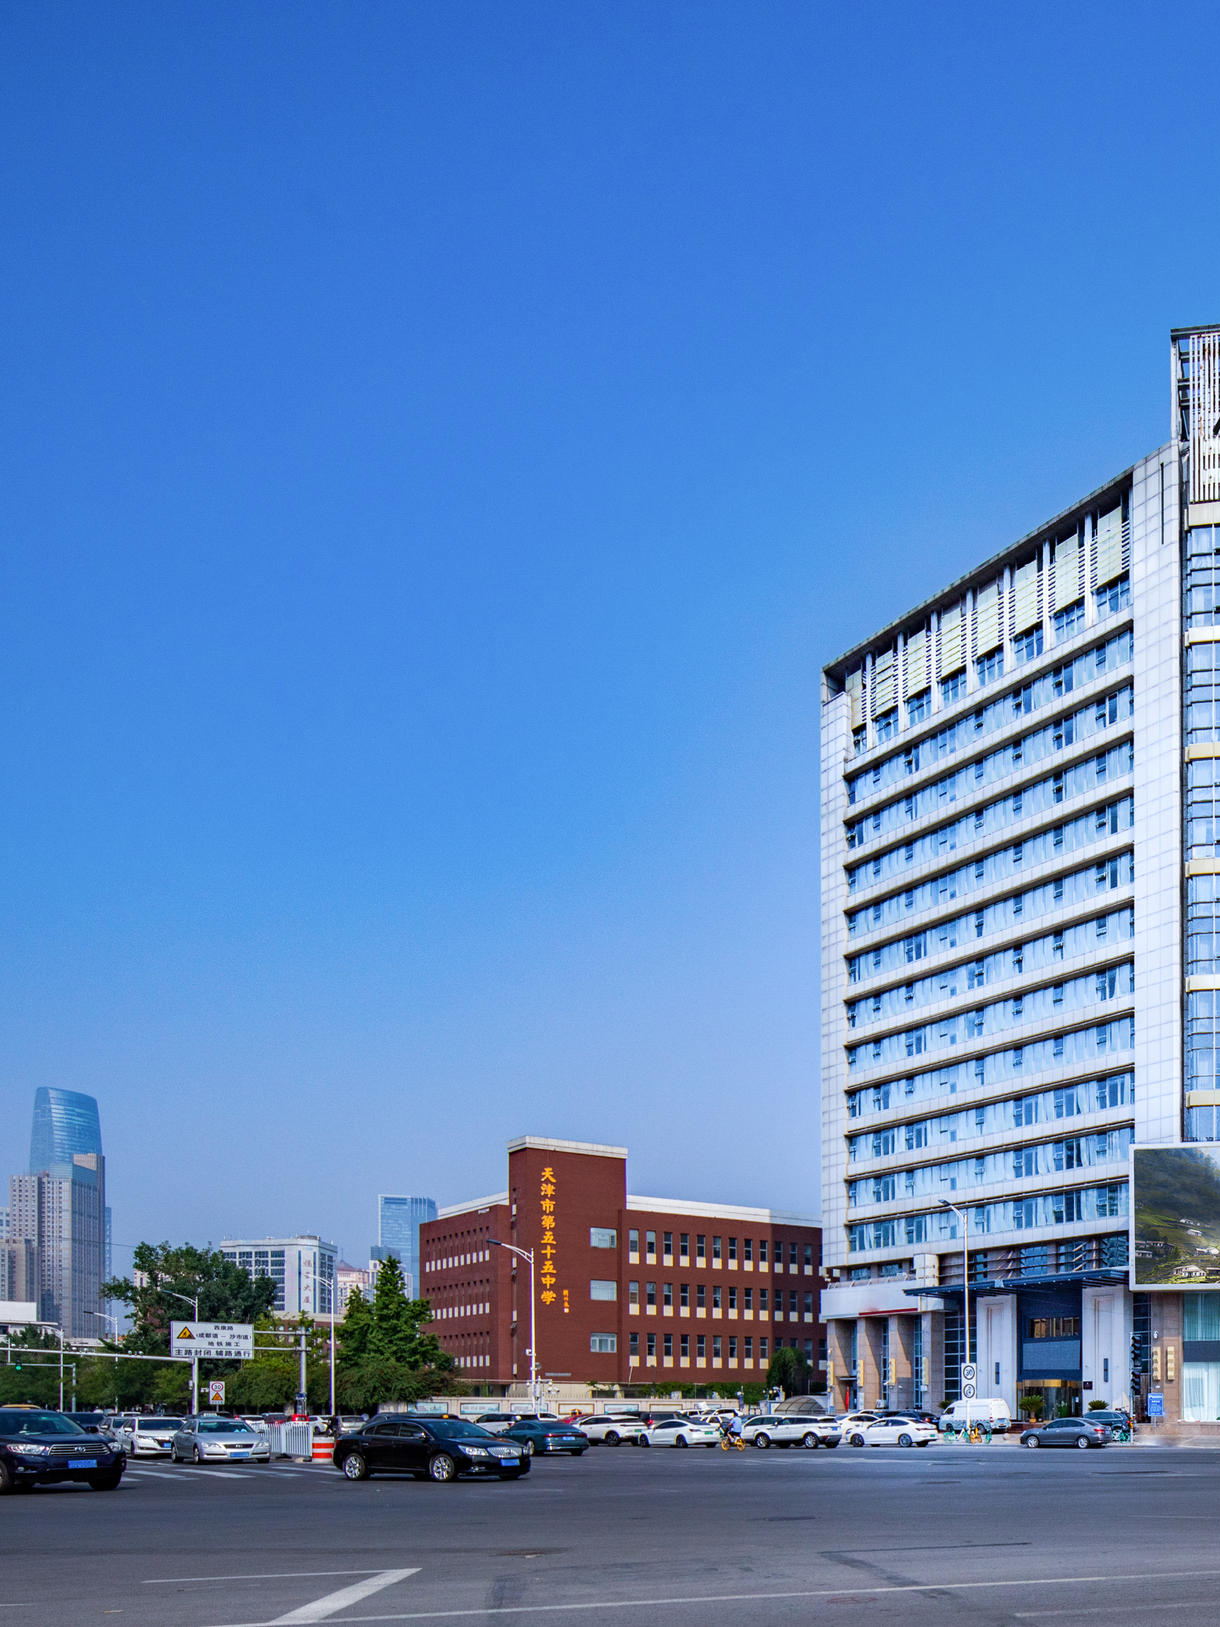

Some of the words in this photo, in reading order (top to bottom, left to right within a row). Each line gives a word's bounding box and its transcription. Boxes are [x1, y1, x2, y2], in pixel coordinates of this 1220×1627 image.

[540, 1167, 557, 1305] 天津市第五十五中学
